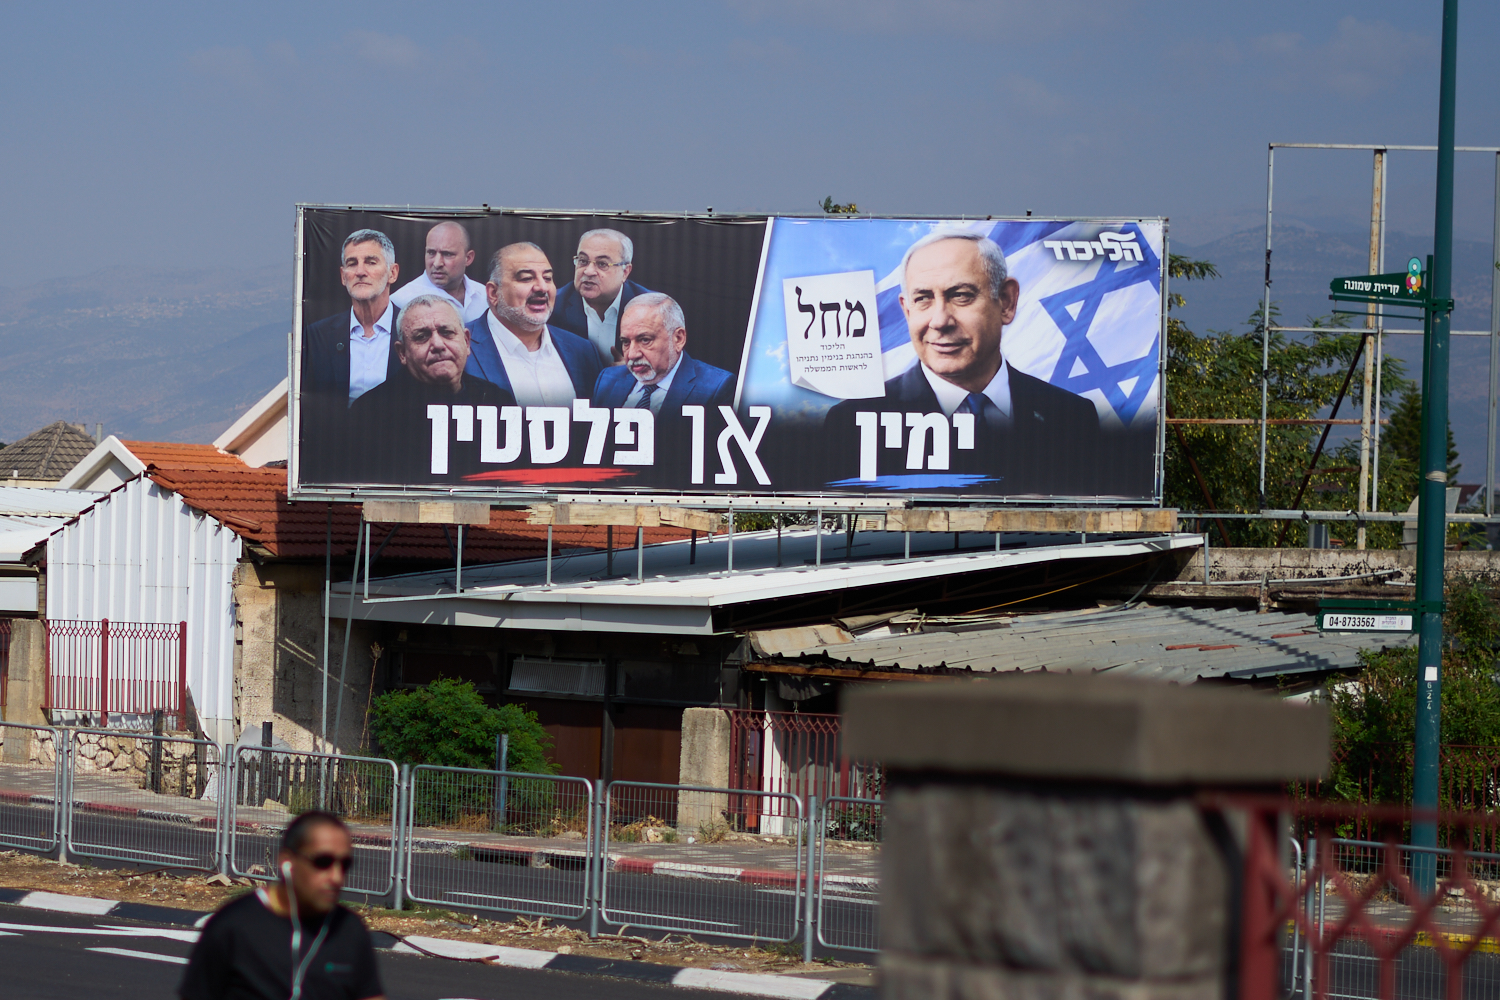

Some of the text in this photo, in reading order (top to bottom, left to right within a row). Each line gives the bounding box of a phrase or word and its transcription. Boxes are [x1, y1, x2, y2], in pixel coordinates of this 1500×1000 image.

[1043, 231, 1144, 261] הליכוד
[1344, 280, 1400, 295] קריית שמונה
[795, 286, 866, 339] מחל
[821, 354, 844, 362] בנימין
[846, 352, 873, 360] בהנהגת
[804, 363, 868, 373] לראשות הממשלה
[426, 398, 975, 485] ימין או פלסטין
[1329, 616, 1375, 627] 04-8733562
